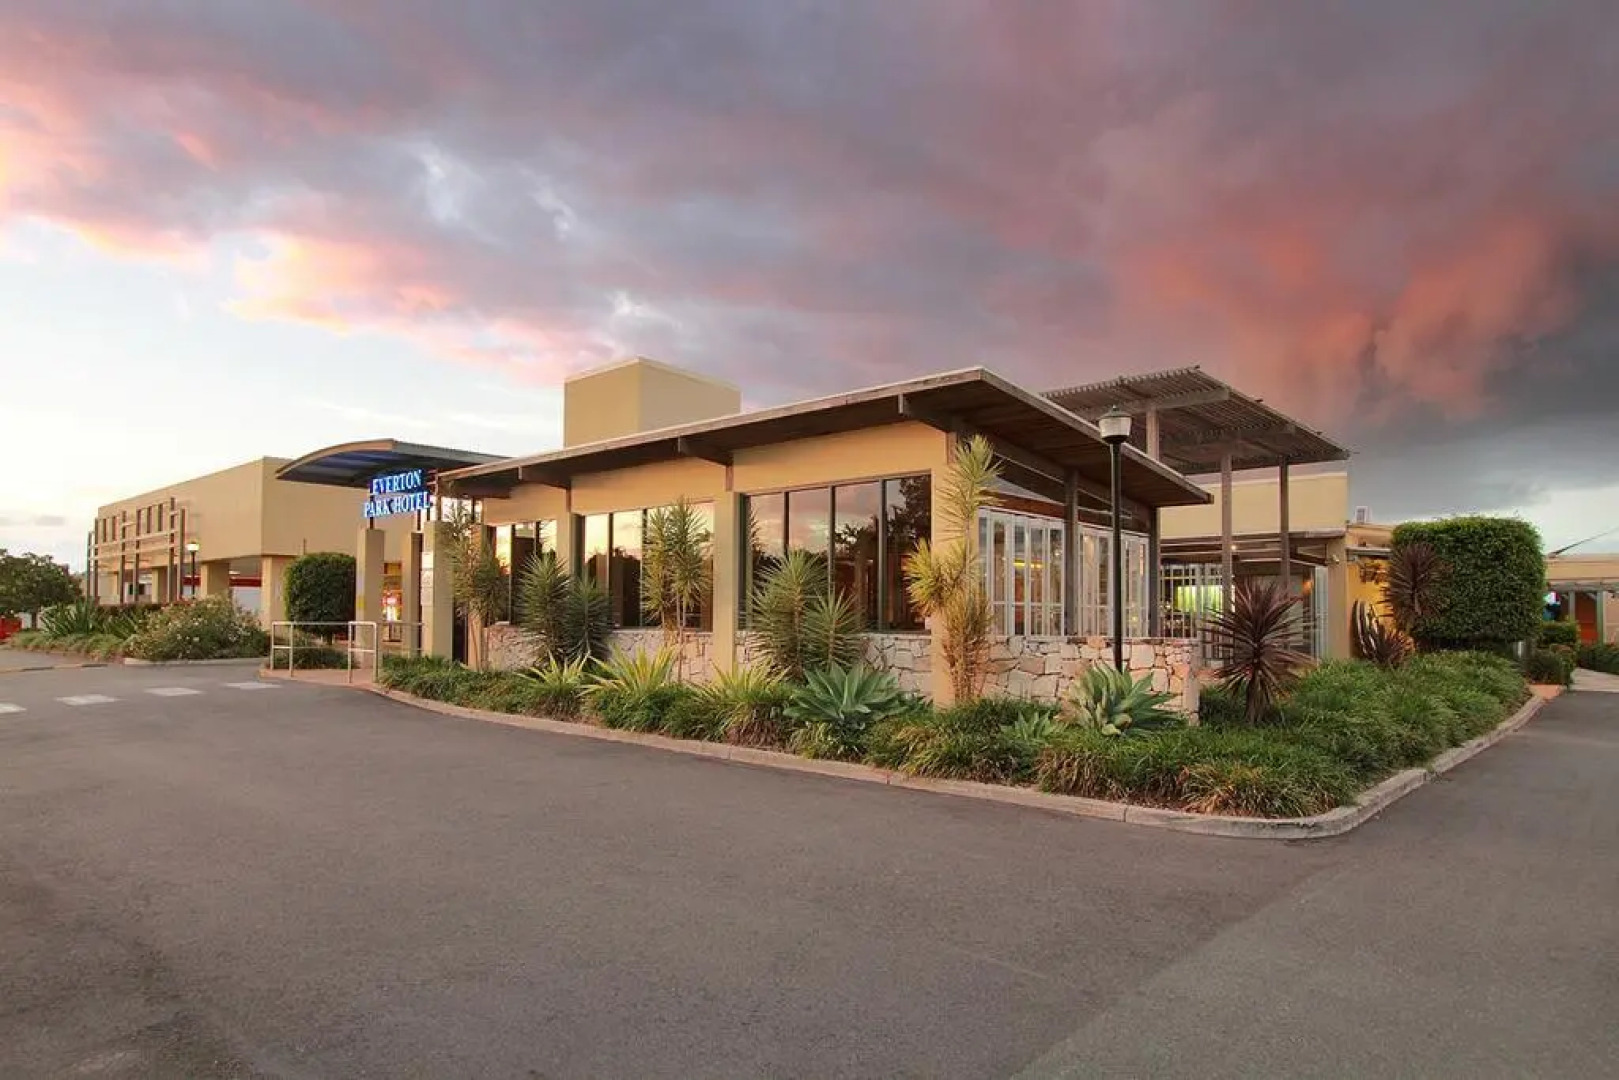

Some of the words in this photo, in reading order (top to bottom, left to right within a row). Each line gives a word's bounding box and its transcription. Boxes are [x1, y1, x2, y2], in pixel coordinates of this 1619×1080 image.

[372, 469, 422, 495] EVERTON
[364, 499, 393, 518] PARK
[394, 491, 430, 514] HOTEL
